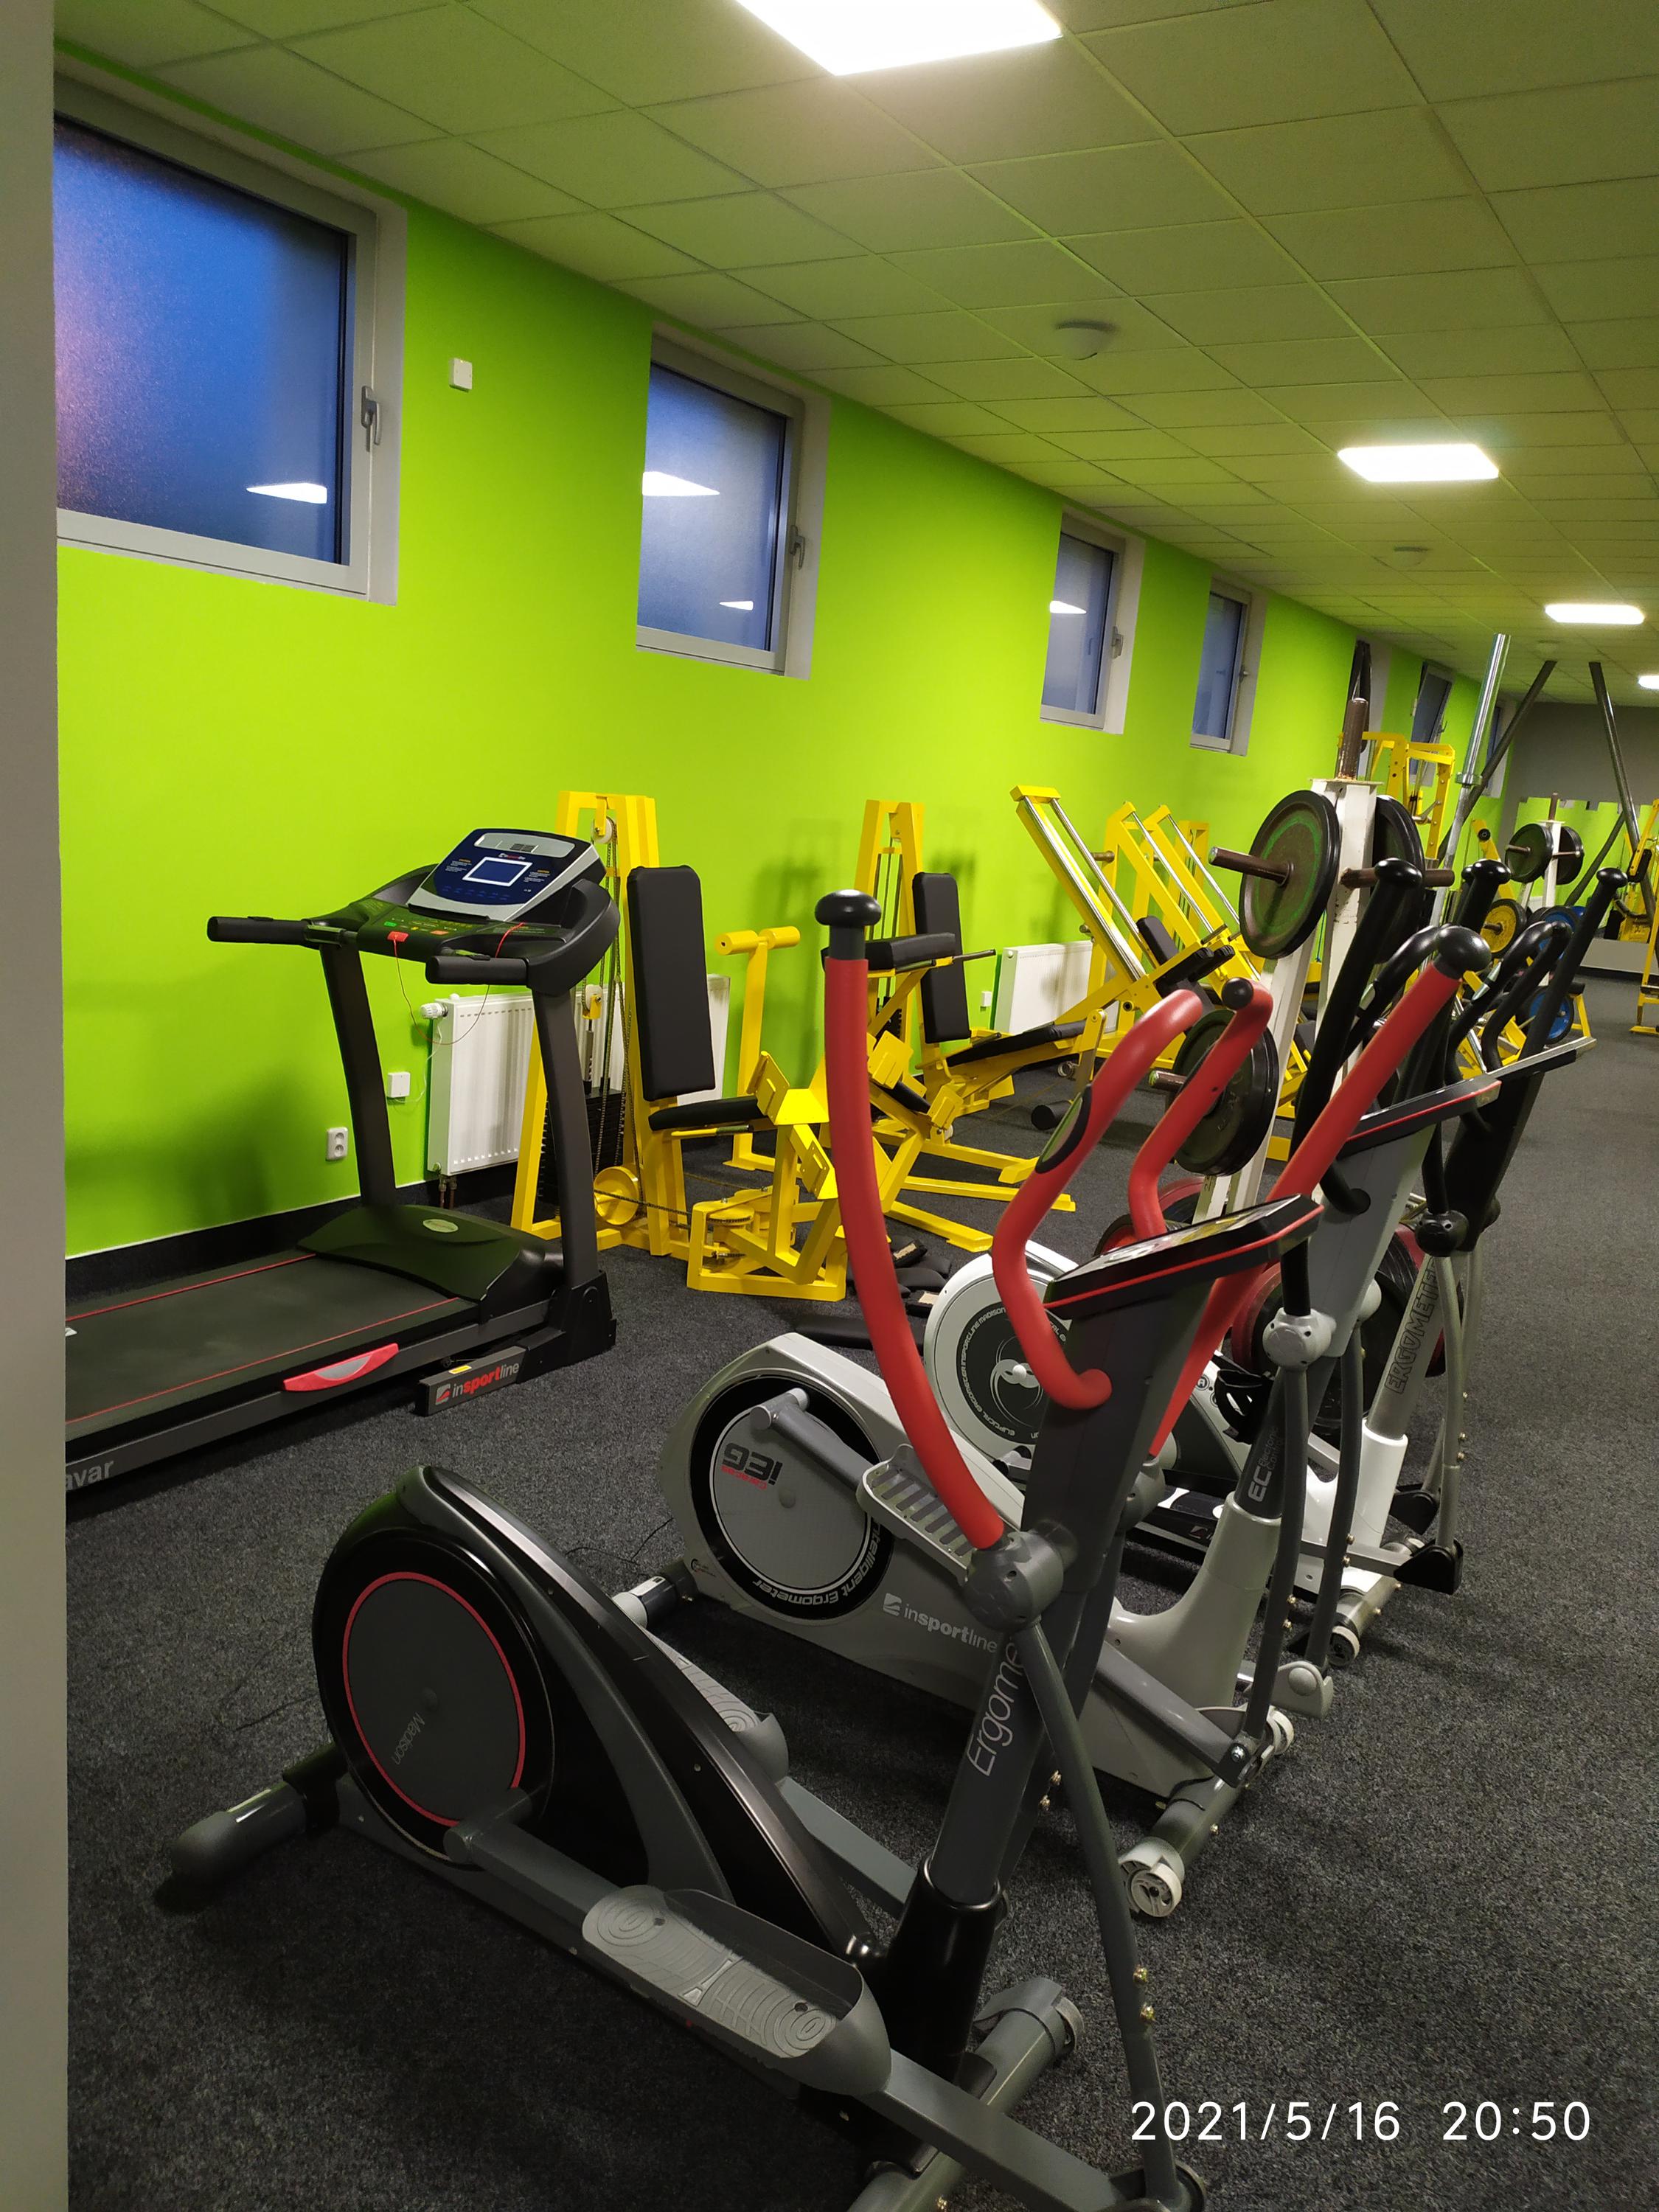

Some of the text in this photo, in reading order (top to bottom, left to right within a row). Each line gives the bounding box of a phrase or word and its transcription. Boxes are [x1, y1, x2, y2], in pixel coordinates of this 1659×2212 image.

[452, 1363, 520, 1398] insportline
[1248, 1464, 1272, 1502] EC
[751, 1523, 882, 1605] ntelligent Ergometer
[904, 1604, 998, 1654] insportline
[967, 1637, 1023, 1776] Ergome
